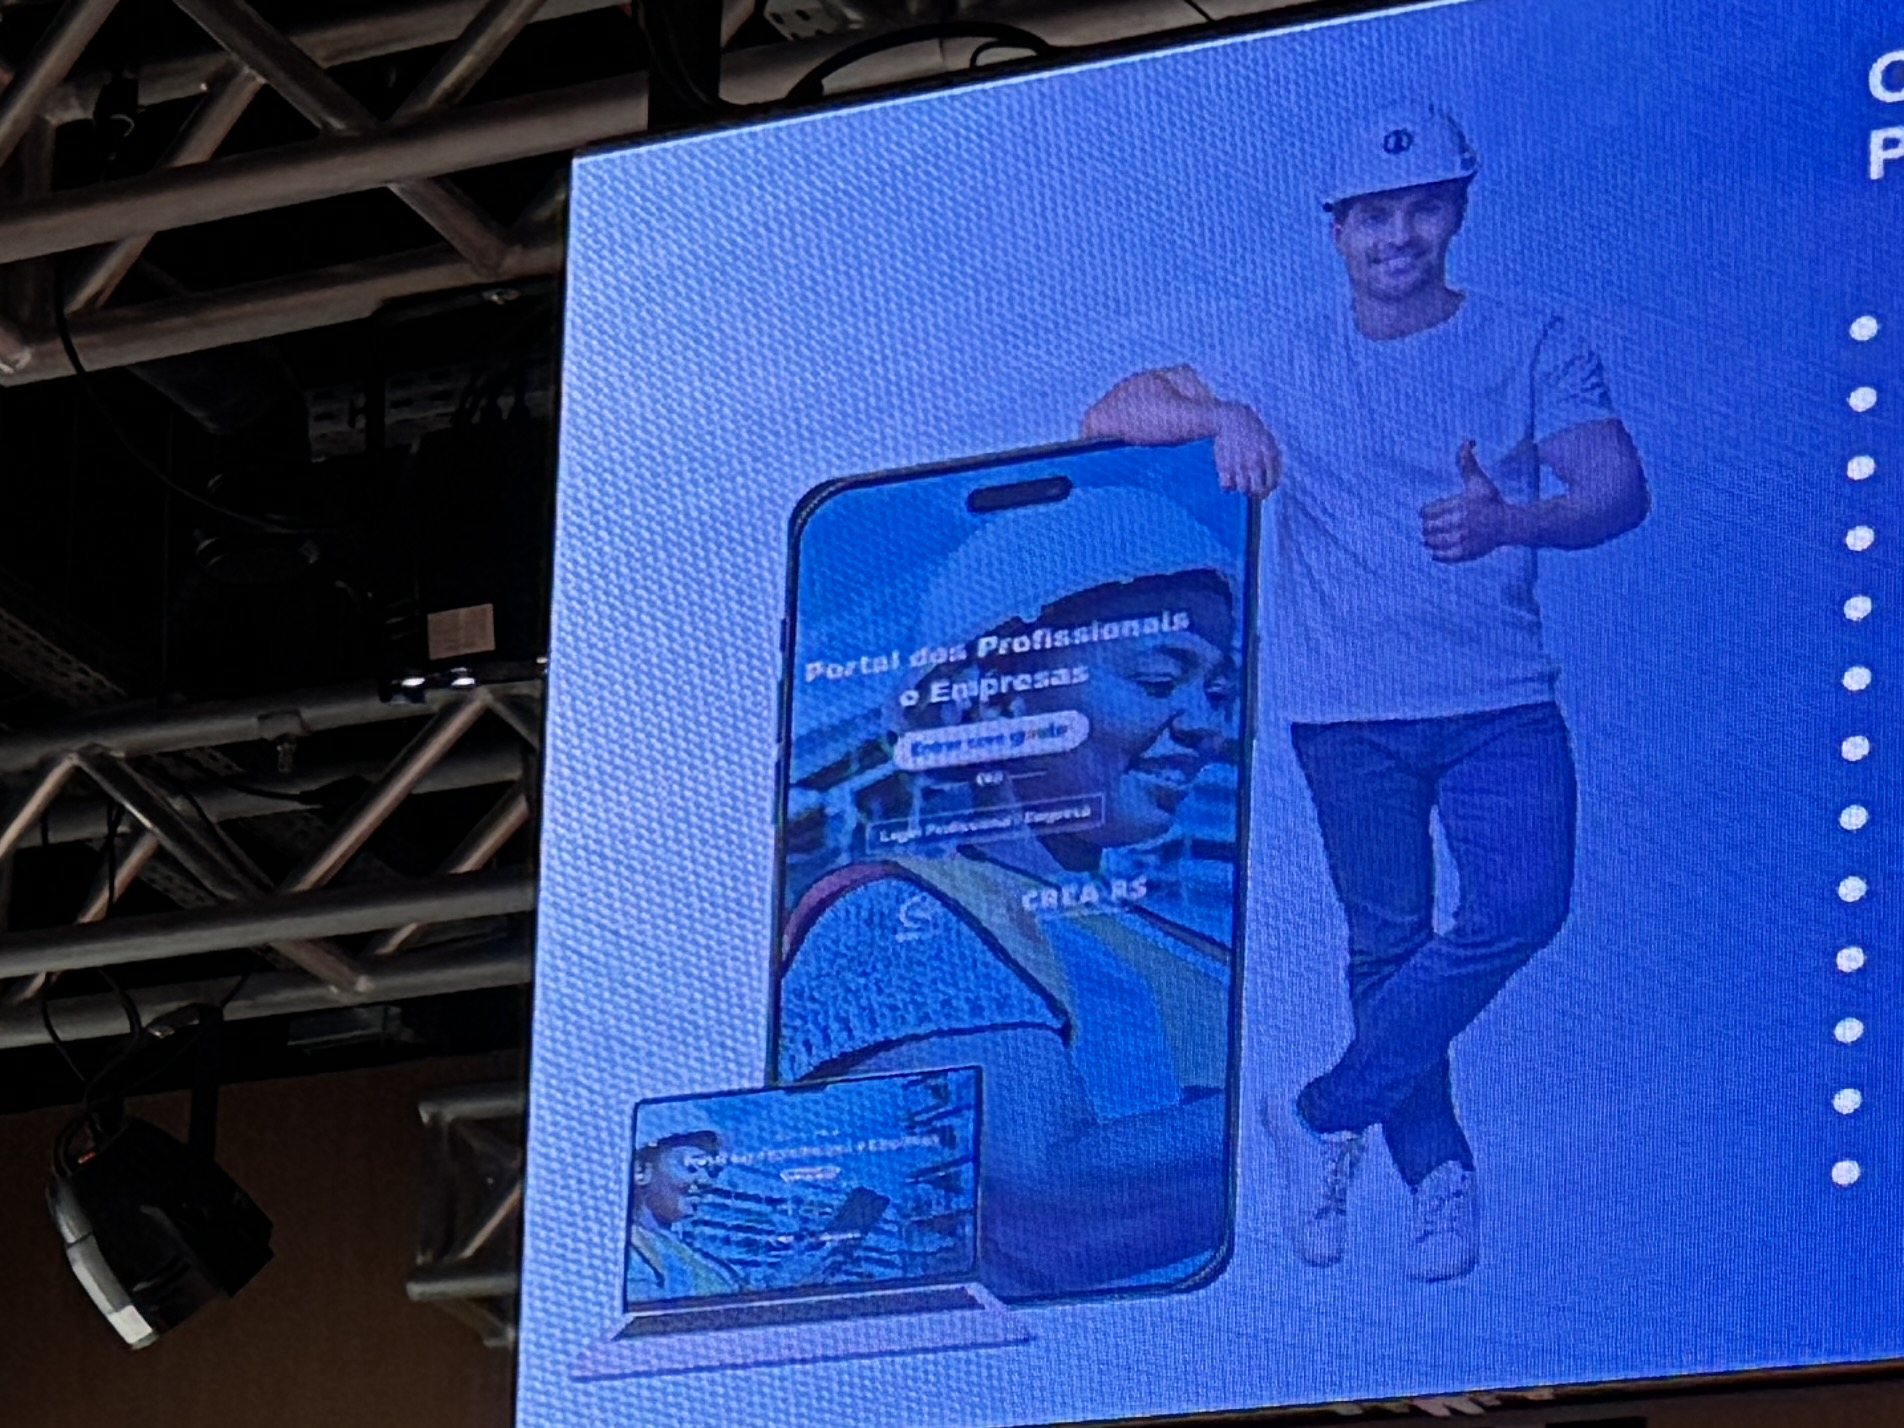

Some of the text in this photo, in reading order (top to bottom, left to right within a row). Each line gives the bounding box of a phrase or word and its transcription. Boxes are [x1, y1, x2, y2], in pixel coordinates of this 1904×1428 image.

[804, 650, 900, 682] Portal
[977, 608, 1191, 658] Profissionais
[929, 663, 1090, 704] Empresas
